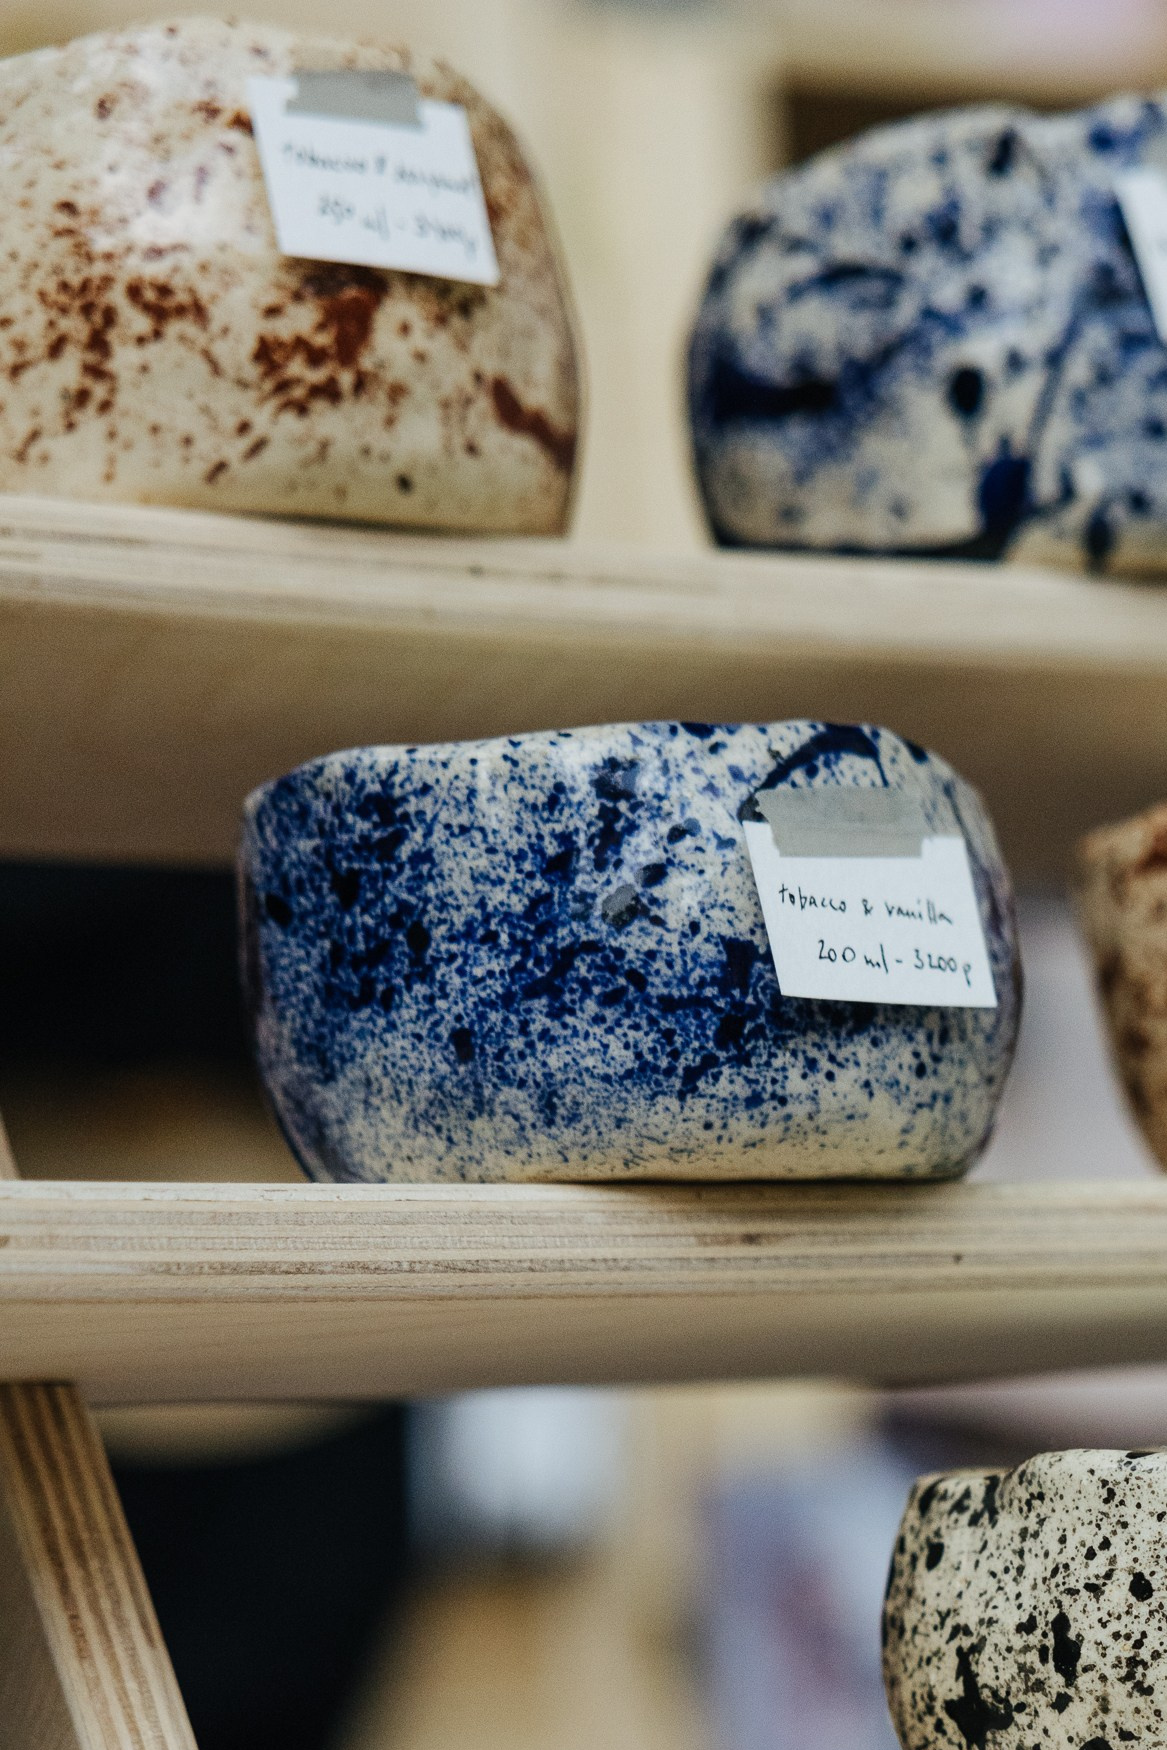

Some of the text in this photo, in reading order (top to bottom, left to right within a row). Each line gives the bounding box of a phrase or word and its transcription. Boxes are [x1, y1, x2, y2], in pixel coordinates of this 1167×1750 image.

[779, 883, 953, 925] tobacco & vanilla
